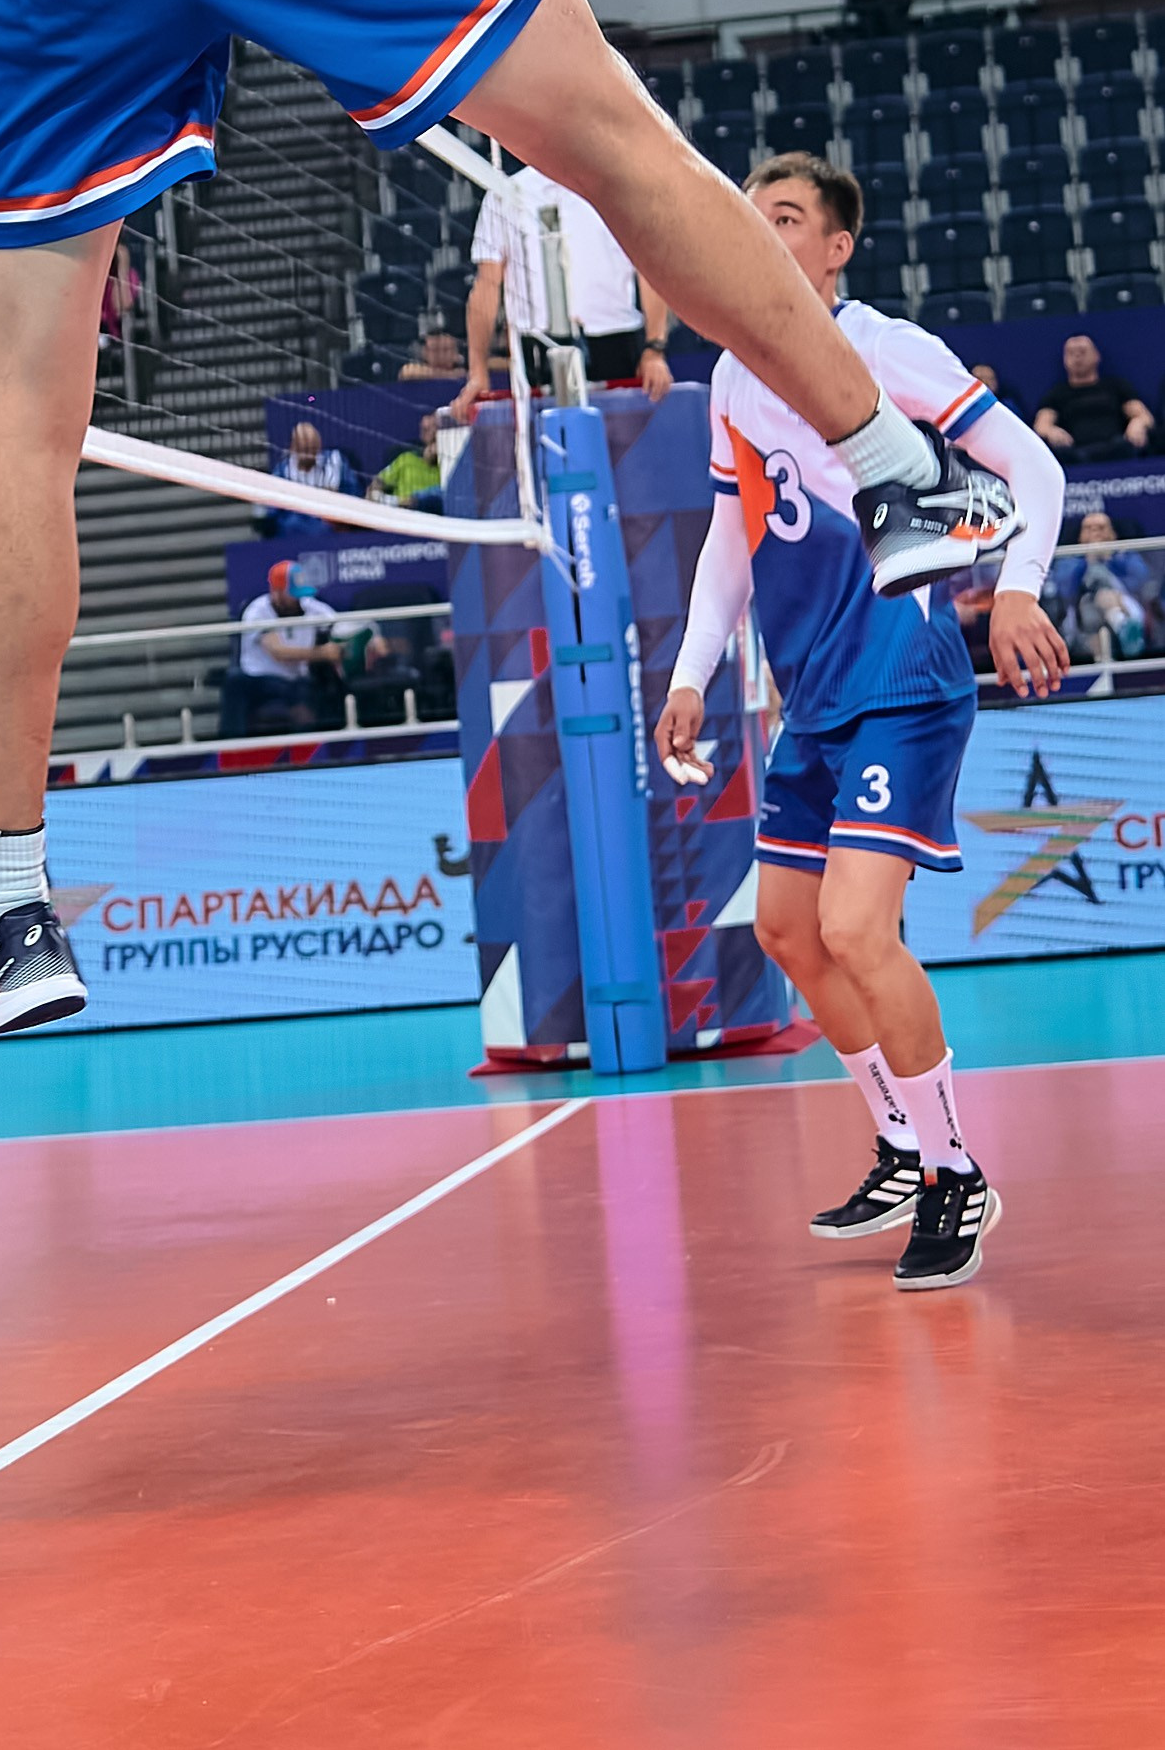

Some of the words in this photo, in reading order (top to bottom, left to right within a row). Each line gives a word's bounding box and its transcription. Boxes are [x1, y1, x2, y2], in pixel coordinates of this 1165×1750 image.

[764, 449, 812, 543] 3
[856, 764, 892, 813] 3
[102, 874, 442, 933] СПАРТАКИАДА
[103, 935, 240, 972] ГРУППЫ
[250, 920, 445, 960] РУСГИДРО
